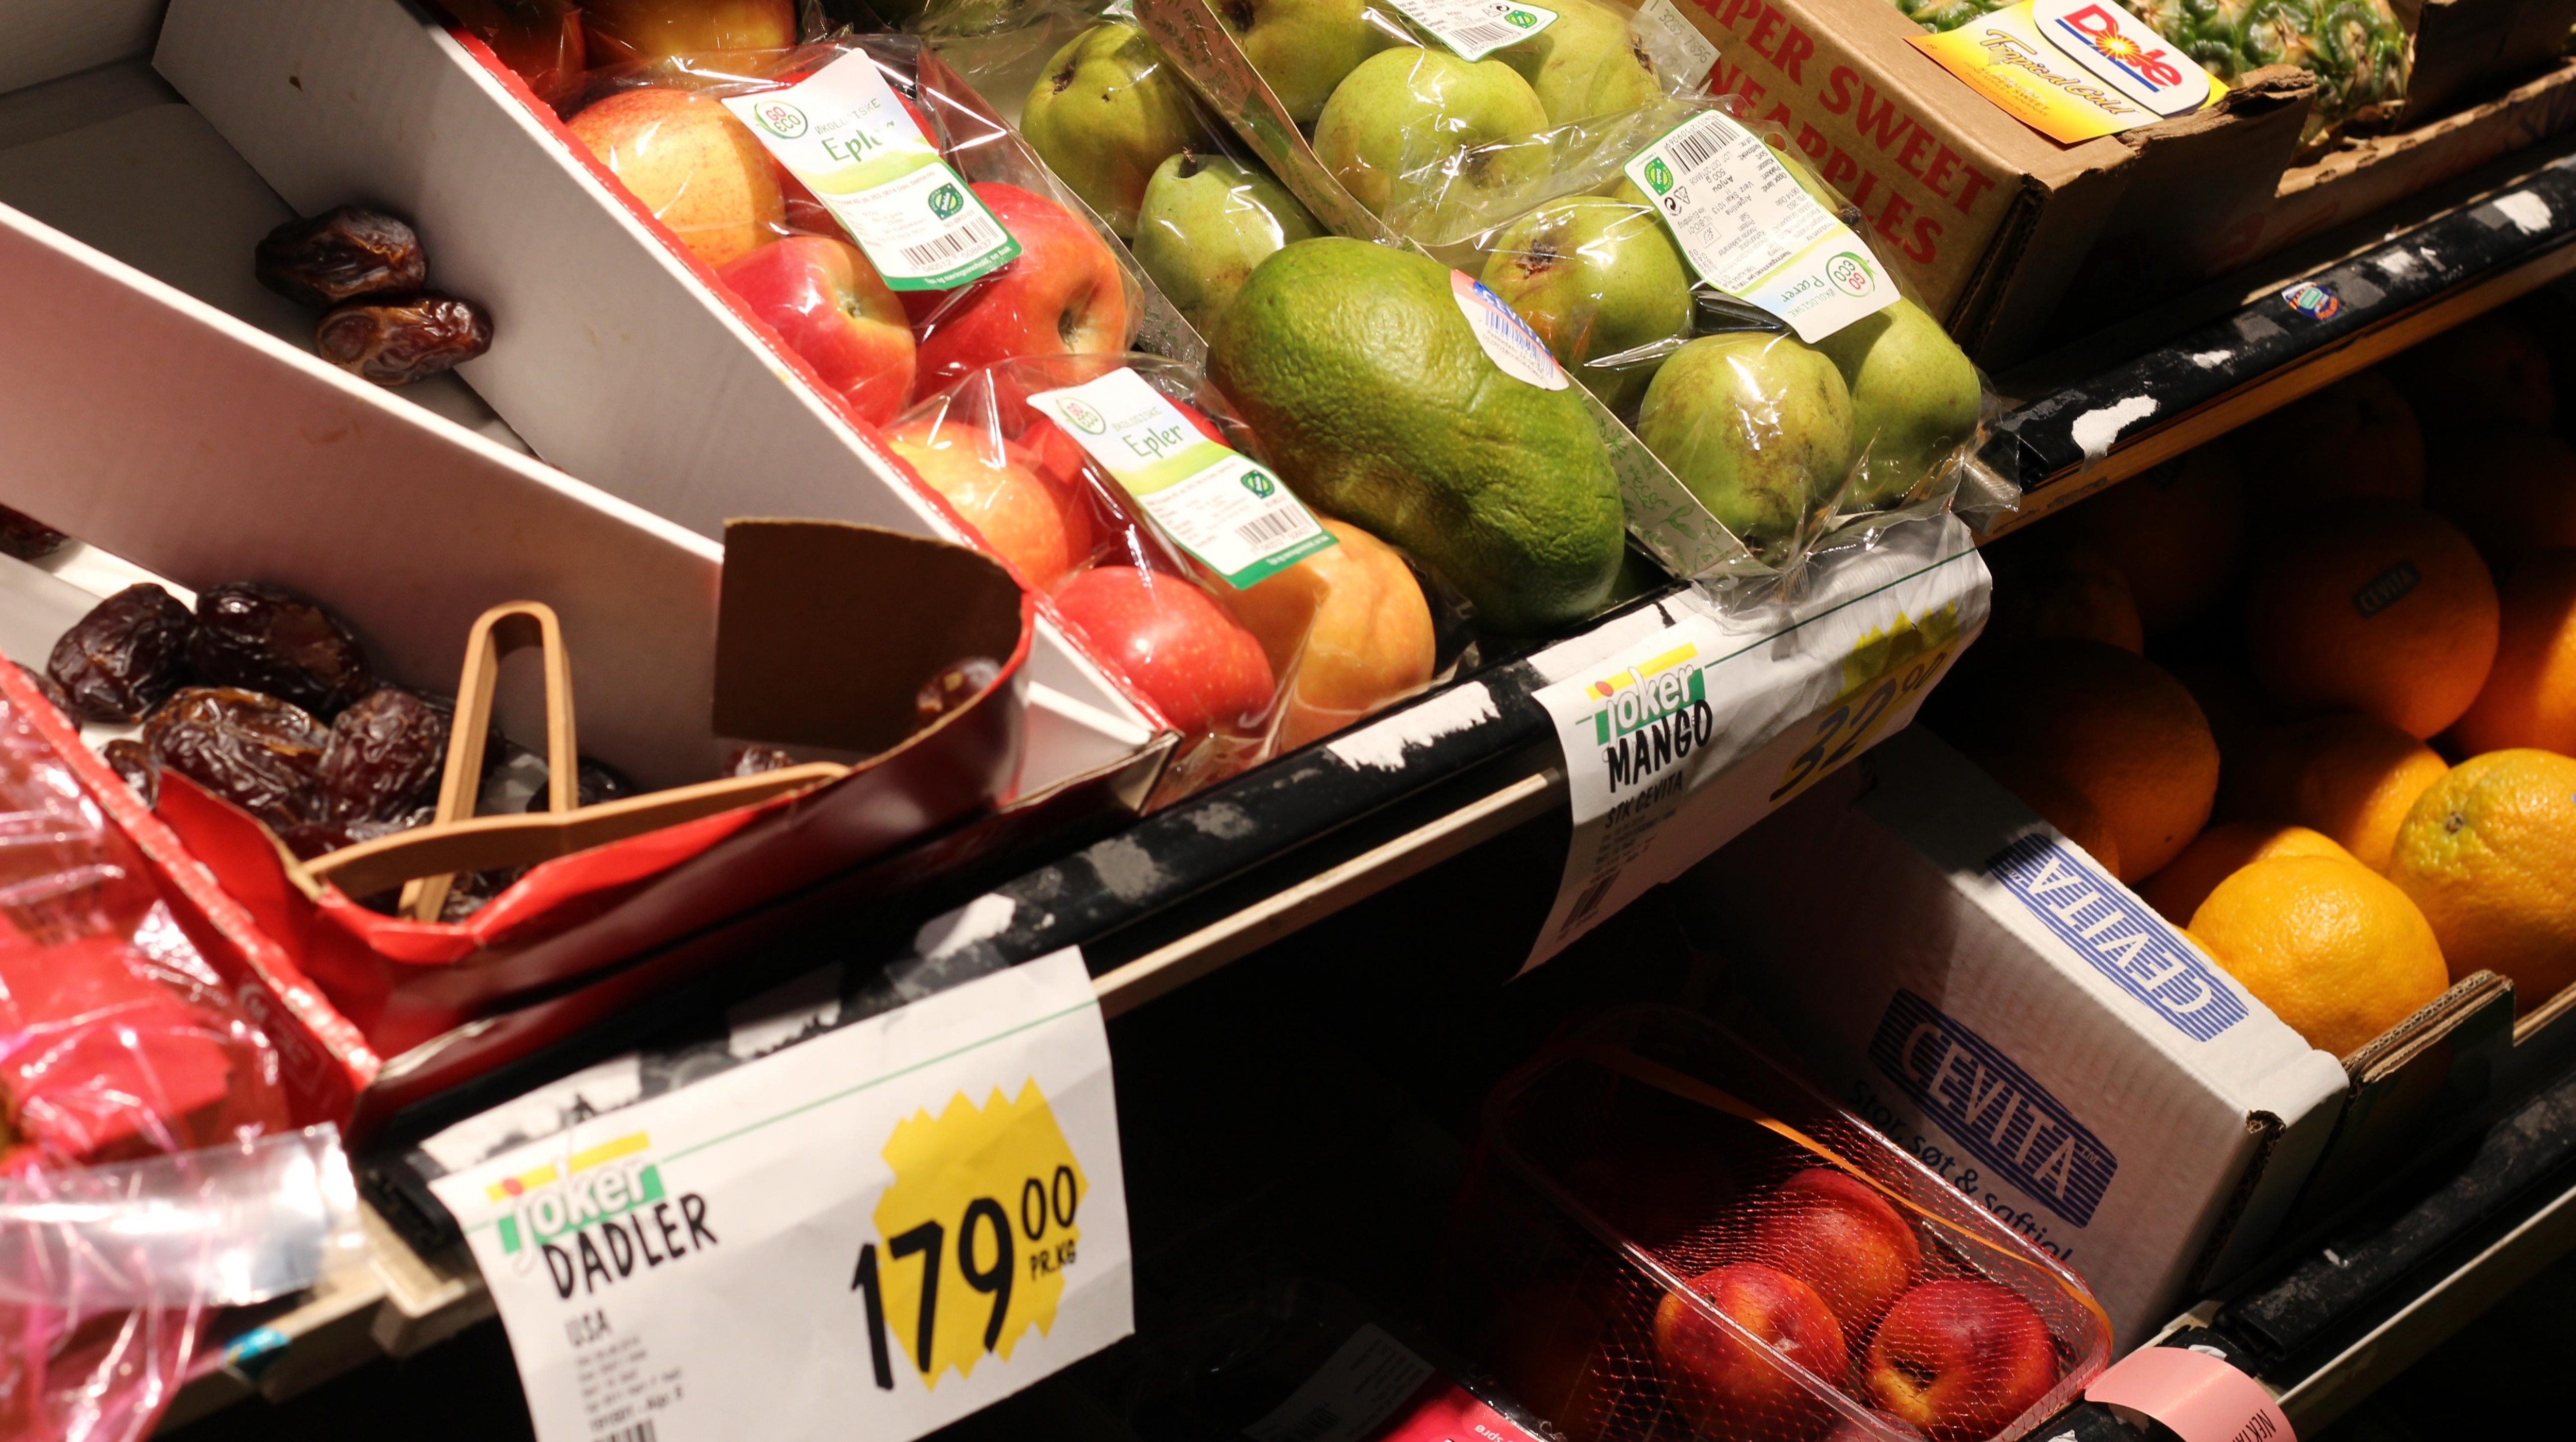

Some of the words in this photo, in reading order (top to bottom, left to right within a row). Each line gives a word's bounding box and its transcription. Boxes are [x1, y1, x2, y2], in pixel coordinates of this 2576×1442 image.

[1979, 29, 2080, 88] Tropical
[2064, 77, 2134, 115] Gold
[765, 107, 786, 121] GO
[2012, 87, 2051, 114] SWEET
[773, 114, 801, 132] ECO
[1664, 127, 1692, 149] 509069
[1818, 65, 1995, 216] SWEET
[1711, 167, 1726, 181] 500
[1711, 173, 1734, 194] Anjou
[1738, 179, 1754, 194] Verz
[1710, 200, 1726, 215] 1013
[1724, 192, 1752, 217] Argentina
[1785, 186, 1800, 200] 0614
[1686, 213, 1713, 235] NL-BIO-01
[1833, 259, 1855, 282] ECO
[1848, 272, 1866, 290] GO
[1780, 275, 1825, 303] Pærer
[1123, 423, 1184, 459] Epler
[1603, 664, 1697, 760] joker
[1606, 700, 1713, 792] MANGO
[1606, 798, 1634, 828] STK
[1635, 771, 1684, 813] CEVITA
[2027, 856, 2214, 1014] CEVITA
[1902, 1022, 2078, 1200] CEVITA
[1908, 1134, 1956, 1175] søt
[1954, 1168, 1979, 1196] &
[513, 1157, 650, 1273] joker
[540, 1193, 718, 1301] DADLER
[1030, 1239, 1077, 1282] PR.KG
[851, 1197, 1015, 1391] 179
[1021, 1164, 1078, 1242] 00
[565, 1311, 612, 1348] USA
